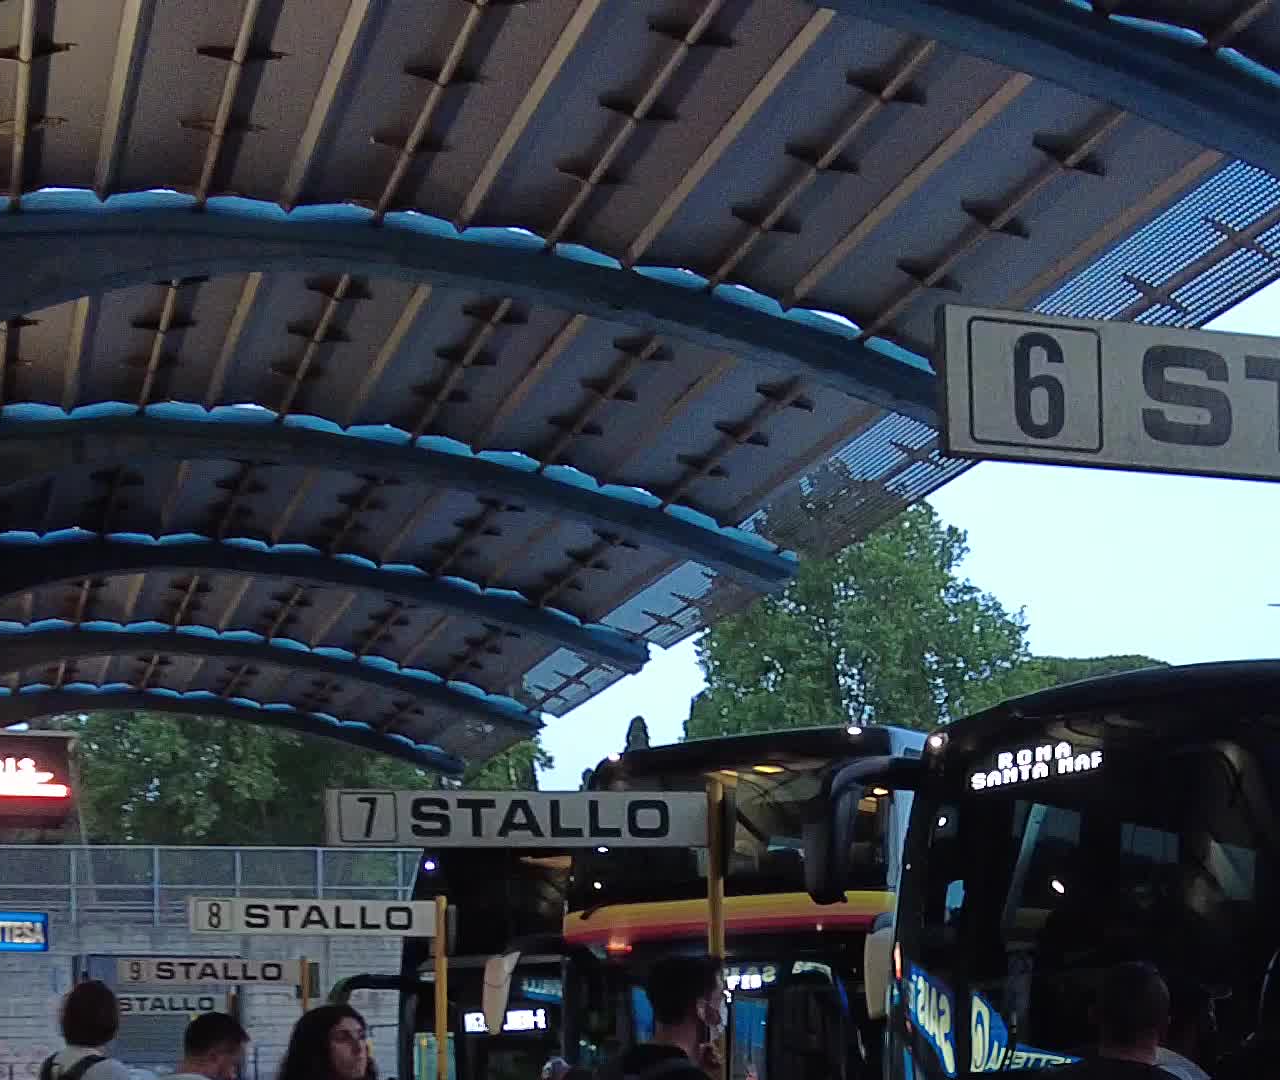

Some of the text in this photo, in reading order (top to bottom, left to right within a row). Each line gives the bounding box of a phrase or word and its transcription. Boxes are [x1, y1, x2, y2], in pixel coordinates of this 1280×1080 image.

[1013, 332, 1065, 440] 6
[998, 741, 1072, 770] ROMA
[971, 761, 1049, 790] SANTA
[358, 796, 670, 838] 7 STALLO
[208, 902, 413, 930] 8 STALLO
[156, 961, 282, 981] STALLO
[119, 996, 215, 1012] STALLO
